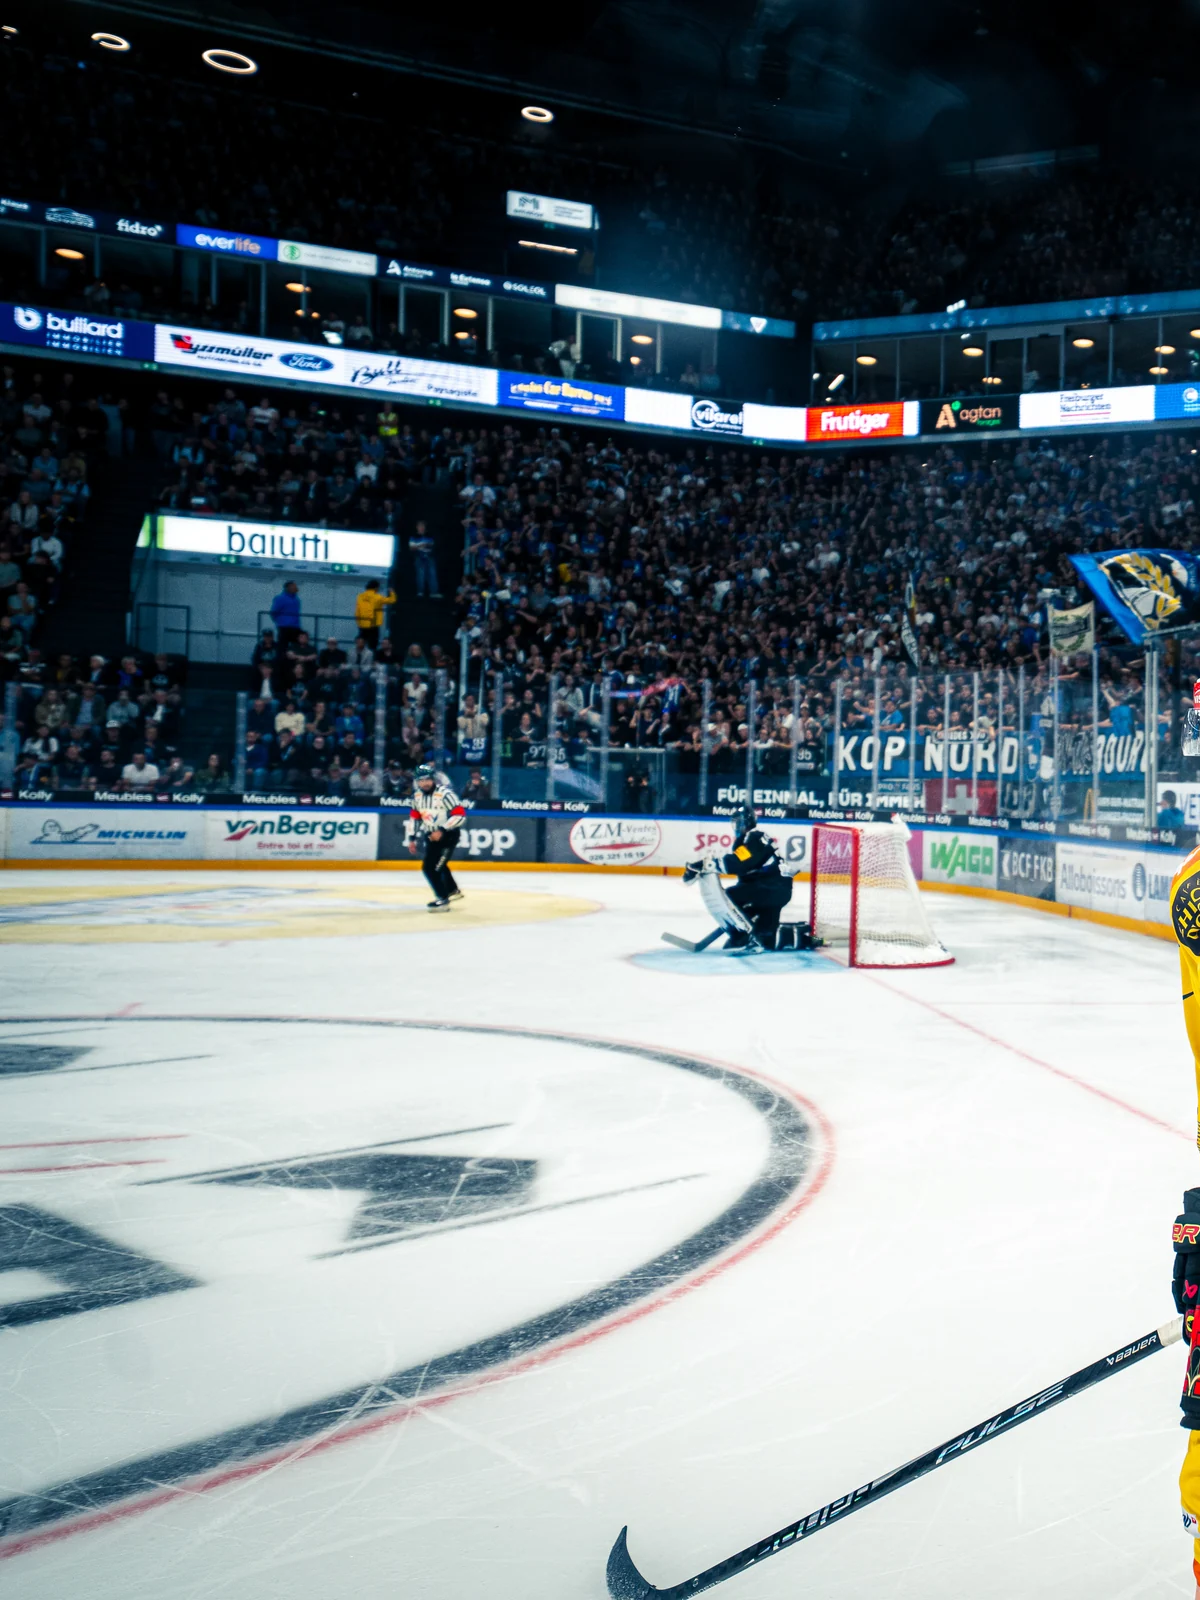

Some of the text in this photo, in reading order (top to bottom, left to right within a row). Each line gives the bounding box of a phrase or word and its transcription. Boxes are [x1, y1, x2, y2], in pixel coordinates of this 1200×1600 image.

[195, 233, 261, 254] everlife
[820, 410, 890, 433] Frutiger
[227, 525, 329, 560] baiutti
[838, 735, 906, 771] KOP
[18, 790, 52, 801] Kolly
[94, 791, 204, 804] Meubles Kolly
[242, 795, 345, 807] Meubles Kolly
[501, 801, 590, 814] Meubles Kolly
[764, 808, 787, 818] Kolly
[808, 809, 875, 821] Meubles Kolly
[97, 830, 187, 839] MICHELIN
[225, 814, 369, 841] vonBergen
[574, 823, 621, 840] AZM
[930, 836, 994, 877] WAGO
[1114, 1333, 1158, 1364] BAUER
[936, 1375, 1072, 1464] PULSE
